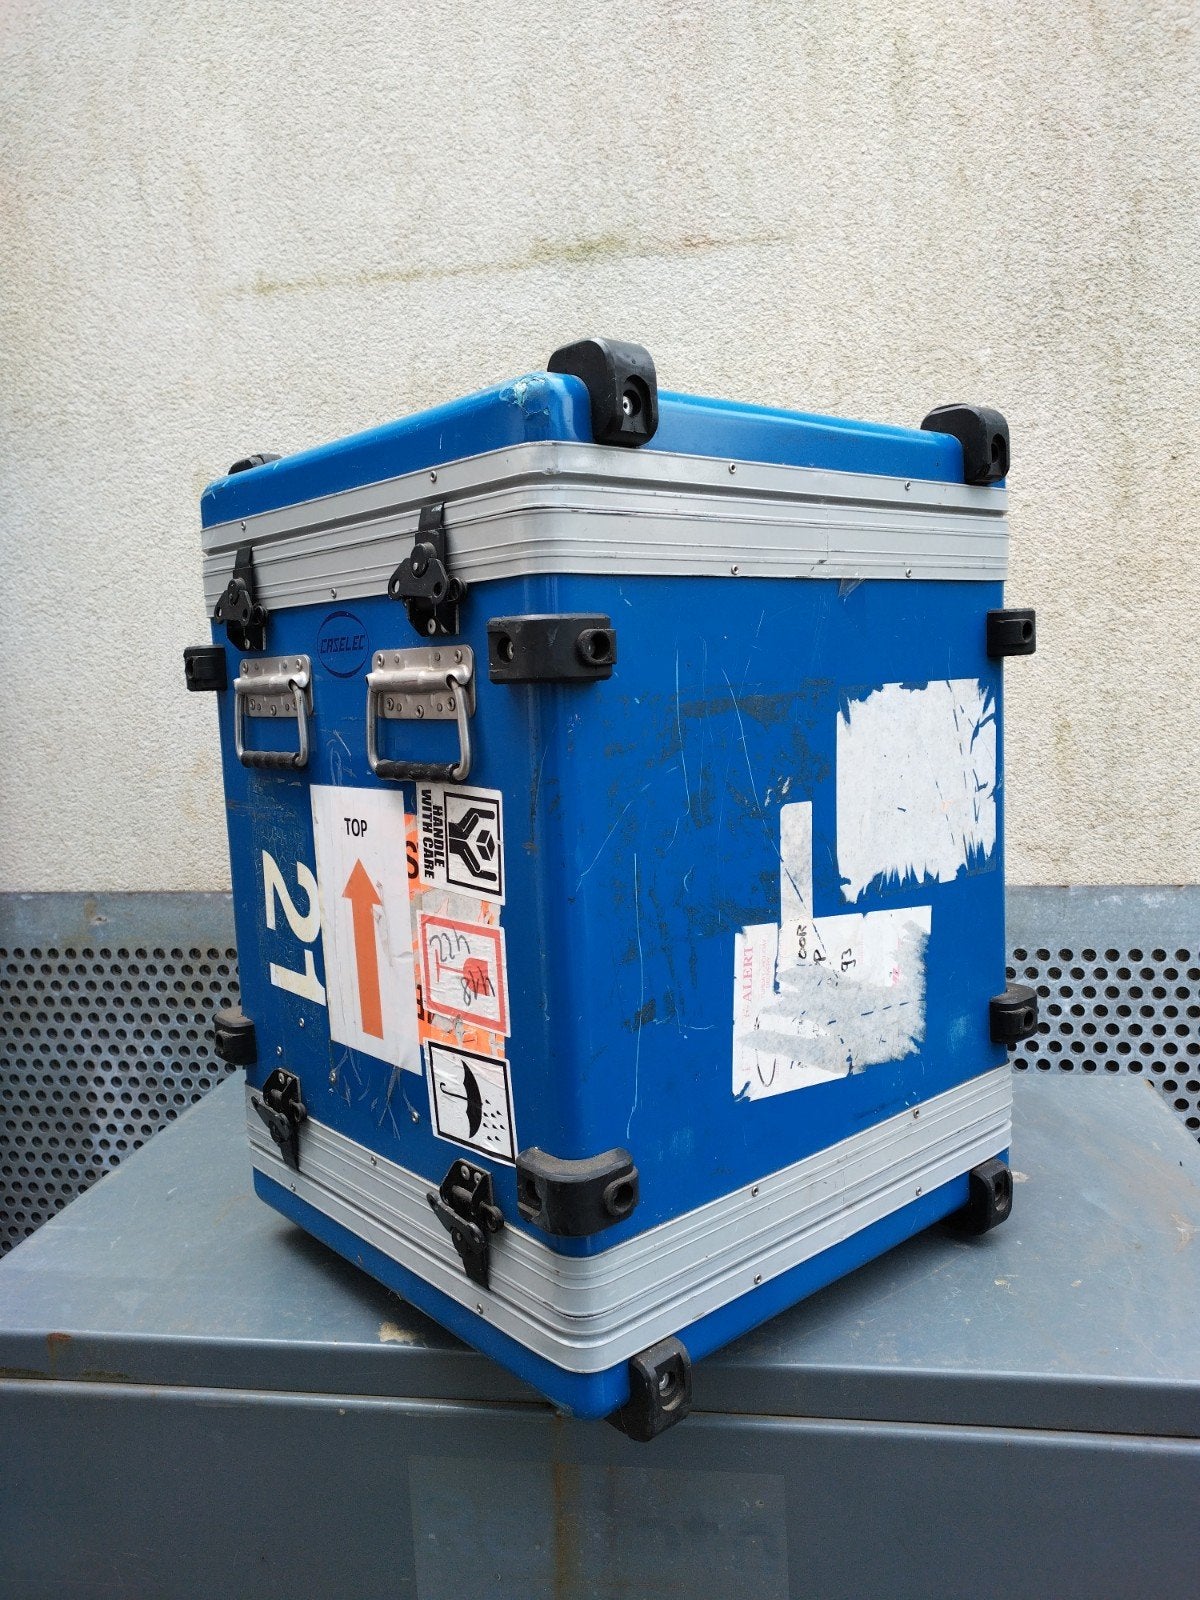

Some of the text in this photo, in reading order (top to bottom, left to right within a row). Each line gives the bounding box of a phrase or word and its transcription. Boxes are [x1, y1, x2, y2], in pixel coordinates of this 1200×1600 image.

[320, 634, 366, 654] CASELEC
[343, 817, 368, 837] TOP
[421, 789, 435, 880] WITH CARE
[432, 804, 446, 868] HANDLE
[261, 849, 327, 1007] 21
